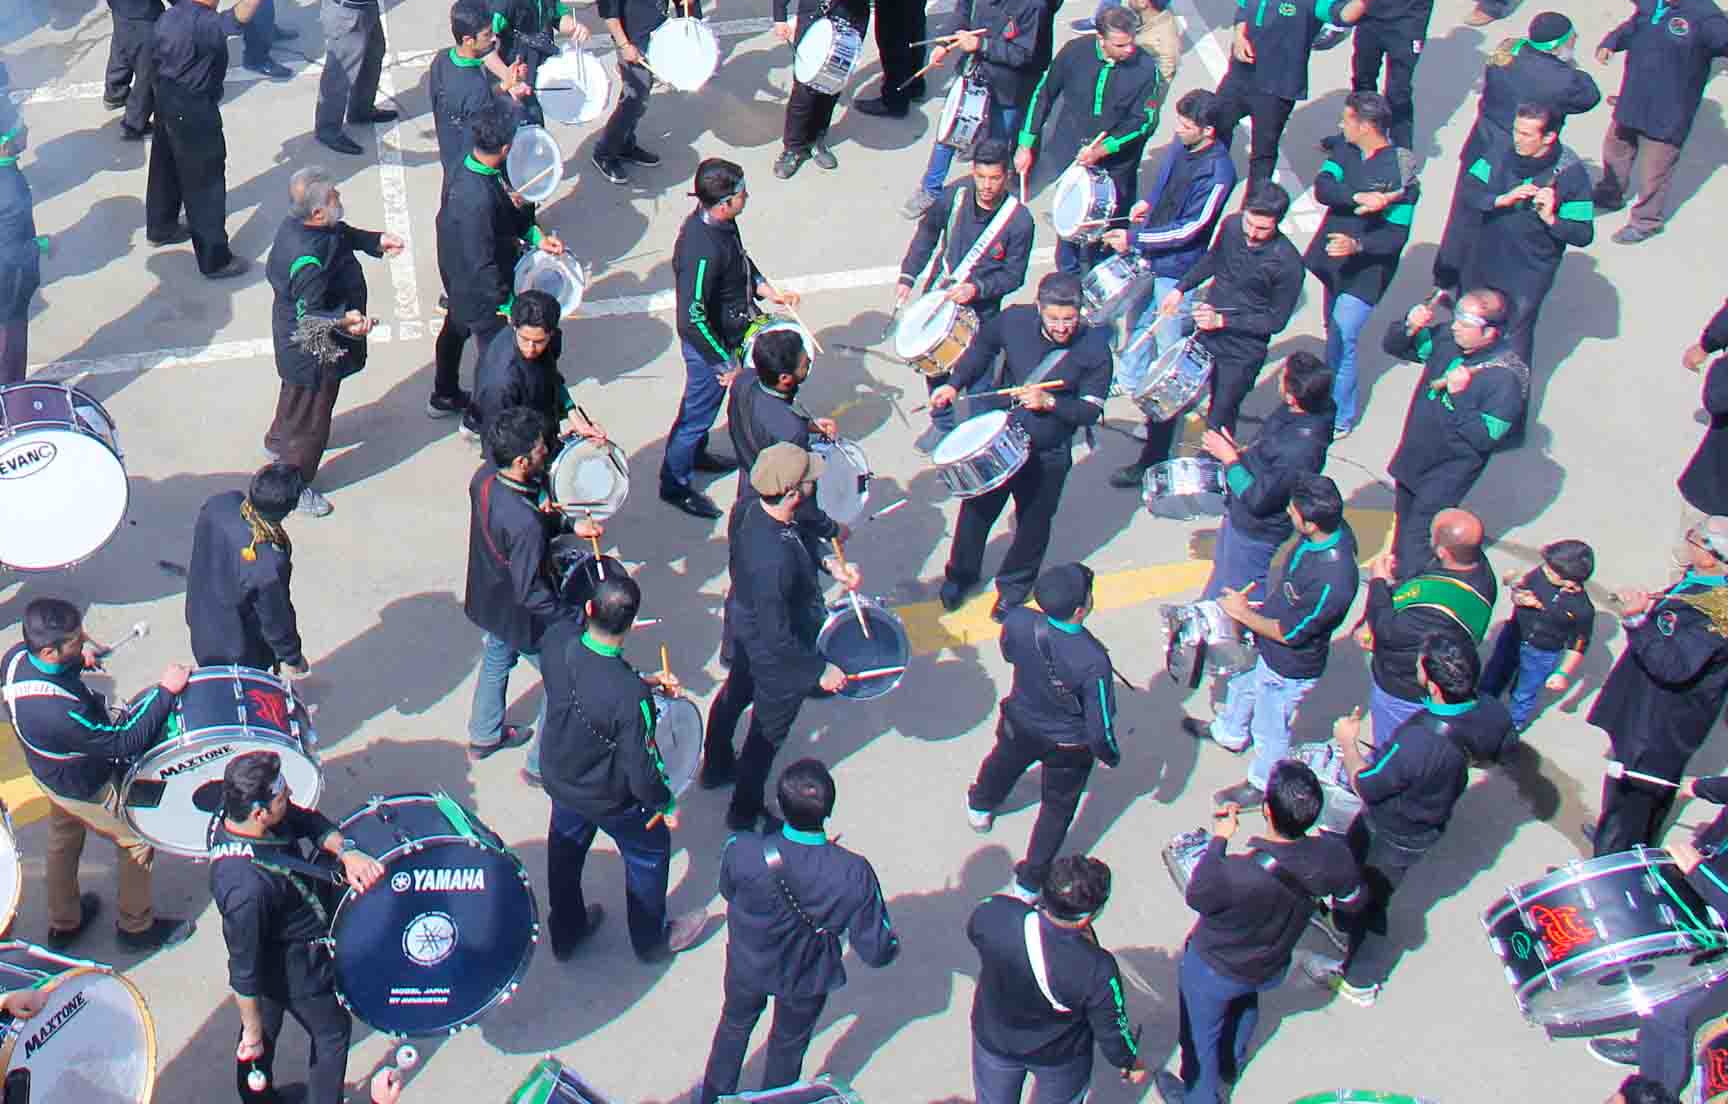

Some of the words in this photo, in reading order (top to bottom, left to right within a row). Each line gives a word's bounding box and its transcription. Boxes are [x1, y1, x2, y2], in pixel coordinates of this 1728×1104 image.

[159, 744, 232, 780] MAXTONE
[413, 868, 485, 892] YAMAHA
[23, 991, 87, 1060] MAXTONE
